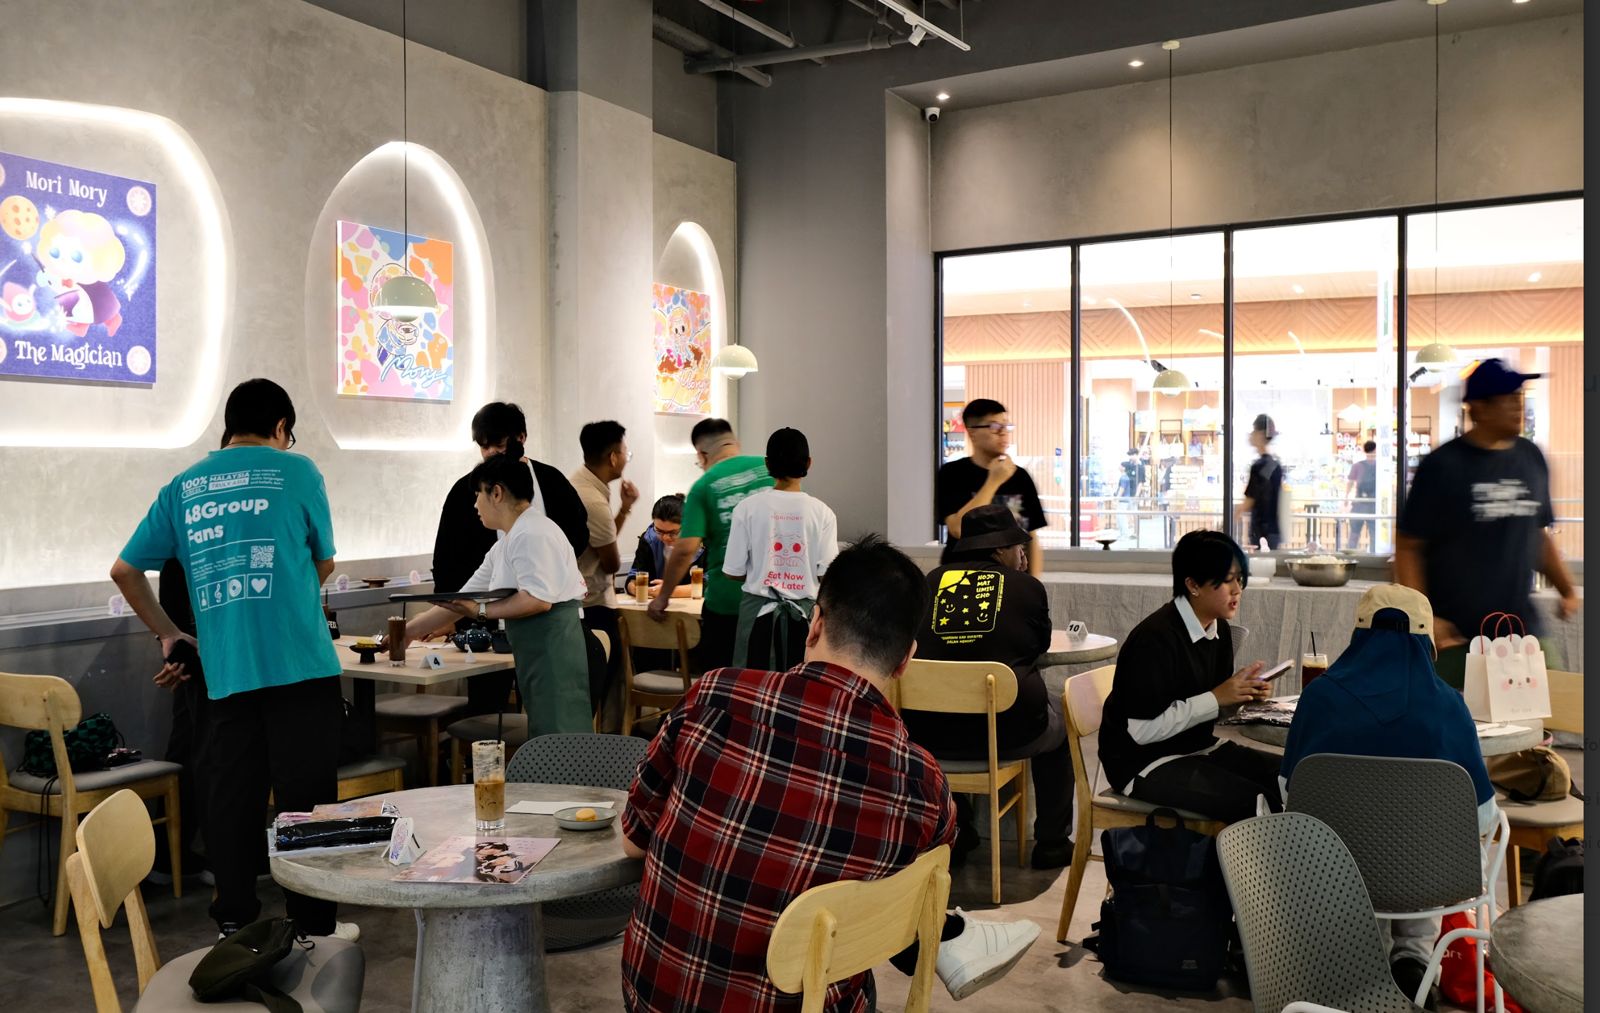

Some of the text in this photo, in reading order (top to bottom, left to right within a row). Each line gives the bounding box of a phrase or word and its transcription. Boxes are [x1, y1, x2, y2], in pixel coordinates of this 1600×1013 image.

[26, 171, 108, 208] Mori Mory
[15, 340, 122, 370] The Magician
[210, 472, 250, 482] MALAYSIA
[182, 476, 208, 491] 100%
[185, 499, 269, 525] 48Group
[187, 525, 224, 546] Fans
[768, 571, 804, 580] Eat Now
[782, 581, 805, 590] Later
[1069, 624, 1080, 632] 10
[433, 656, 441, 666] 4
